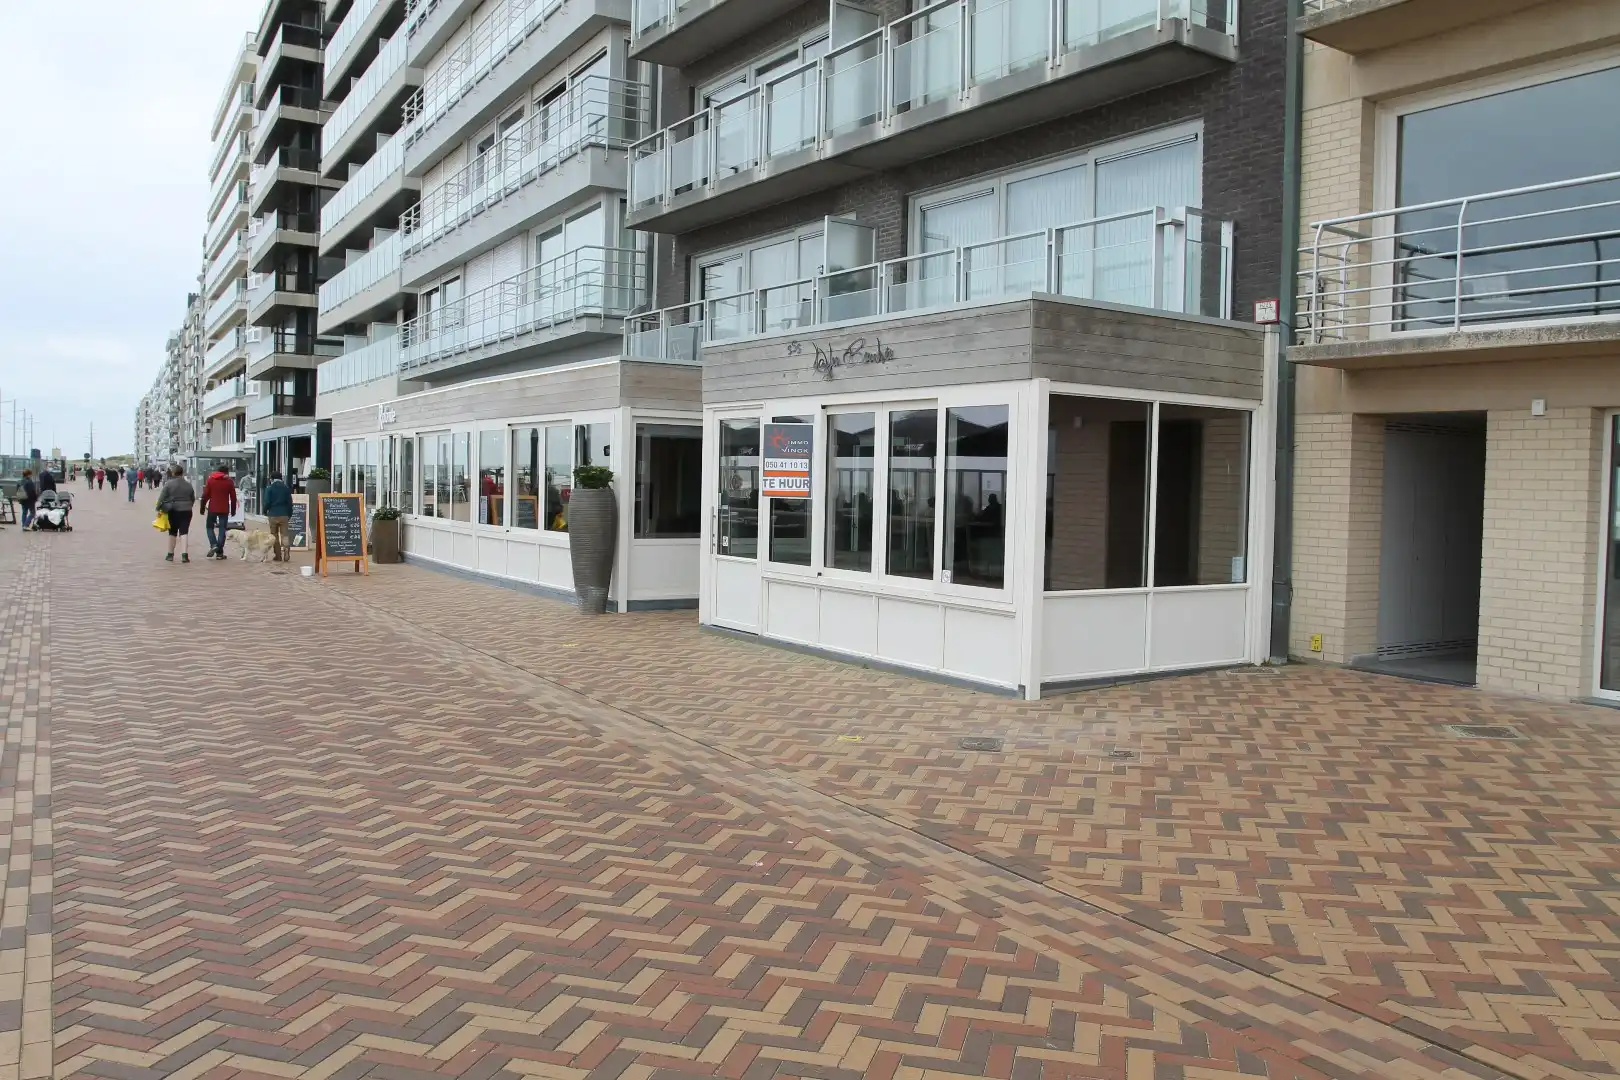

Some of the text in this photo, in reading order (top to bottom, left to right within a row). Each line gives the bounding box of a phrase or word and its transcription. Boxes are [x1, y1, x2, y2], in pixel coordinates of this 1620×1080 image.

[765, 461, 778, 469] 050
[779, 461, 787, 469] 41
[762, 478, 809, 489] TE HUUR
